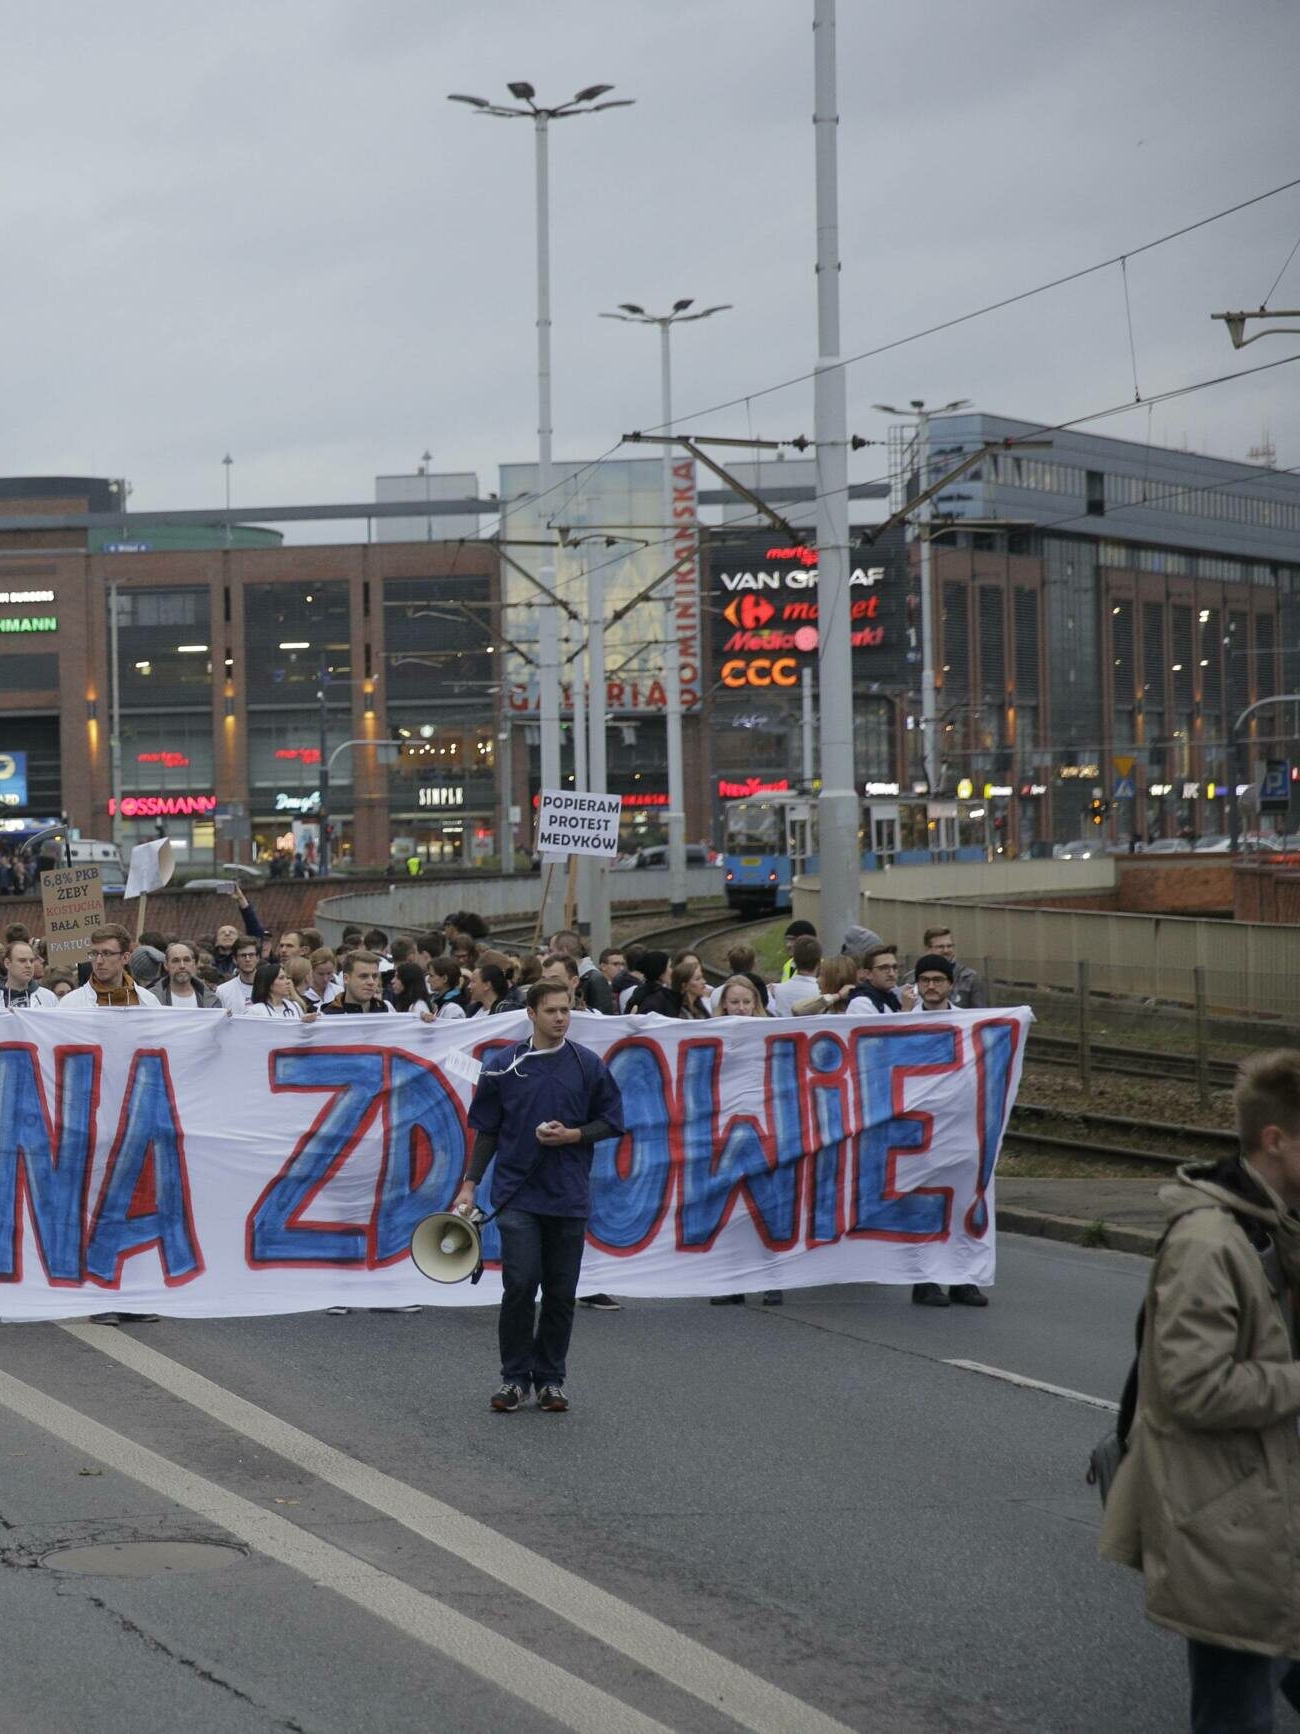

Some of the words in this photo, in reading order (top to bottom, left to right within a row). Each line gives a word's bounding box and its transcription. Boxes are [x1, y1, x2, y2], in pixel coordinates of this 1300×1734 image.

[720, 571, 780, 591] VAN
[785, 567, 885, 589] GRAF
[782, 596, 881, 620] maet
[721, 657, 798, 688] CCC
[510, 682, 668, 713] GLRIA
[418, 787, 464, 806] SIMPLE
[542, 796, 620, 814] POPIERAM
[549, 815, 612, 832] PROTEST
[540, 832, 616, 850] MEDYKÓW
[43, 872, 73, 888] 6,8%
[75, 867, 99, 881] PKB
[57, 885, 89, 900] ŻEBY
[46, 902, 103, 917] KOSTUCHA
[51, 920, 80, 932] BAŁA
[84, 914, 101, 926] SIĘ
[51, 937, 93, 952] FARTUC
